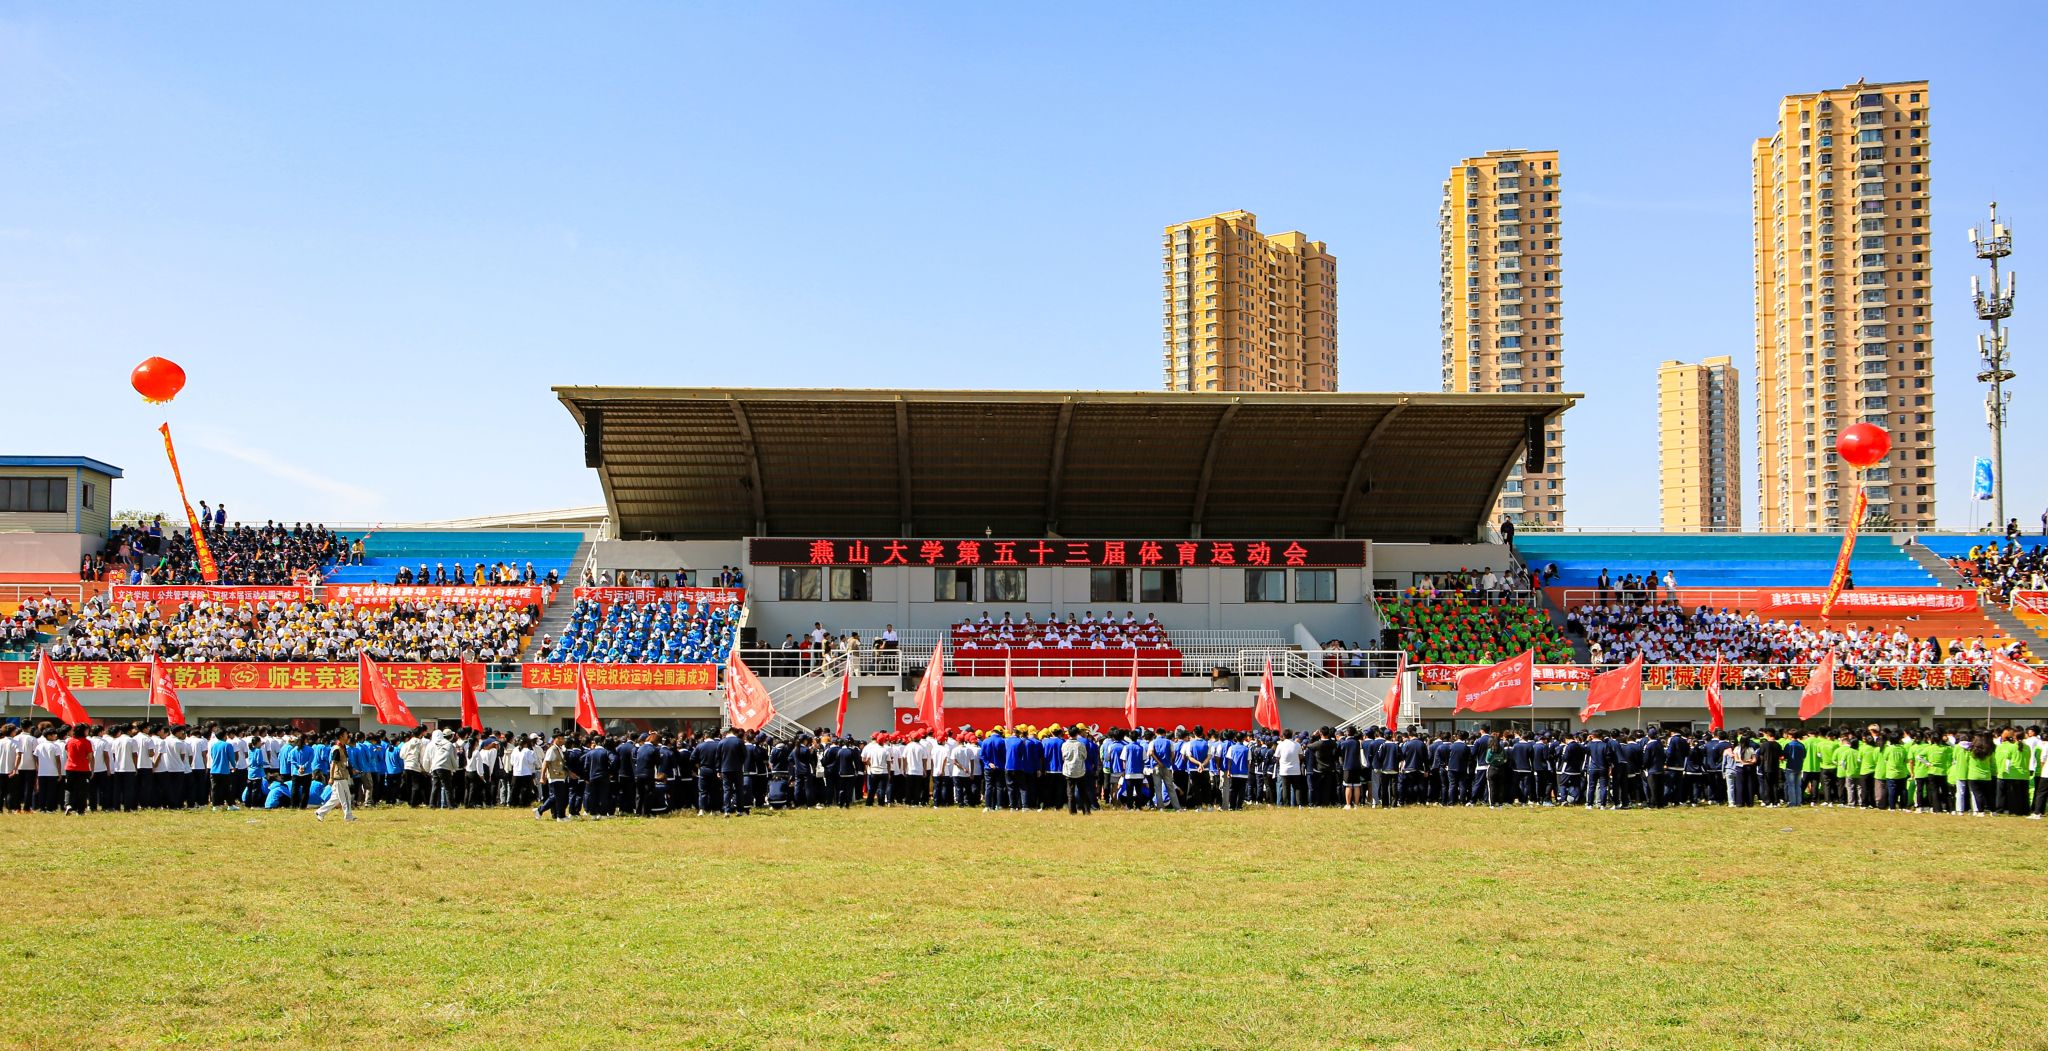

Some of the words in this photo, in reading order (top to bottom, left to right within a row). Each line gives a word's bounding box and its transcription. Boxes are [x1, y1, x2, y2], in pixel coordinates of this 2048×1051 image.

[809, 540, 1308, 565] 燕山大学第五十三届体育运动会
[18, 665, 112, 689] 电青春
[127, 665, 221, 689] 气乾坤
[268, 665, 360, 689] 师生竞逐
[1766, 666, 1856, 687] 斗志扬
